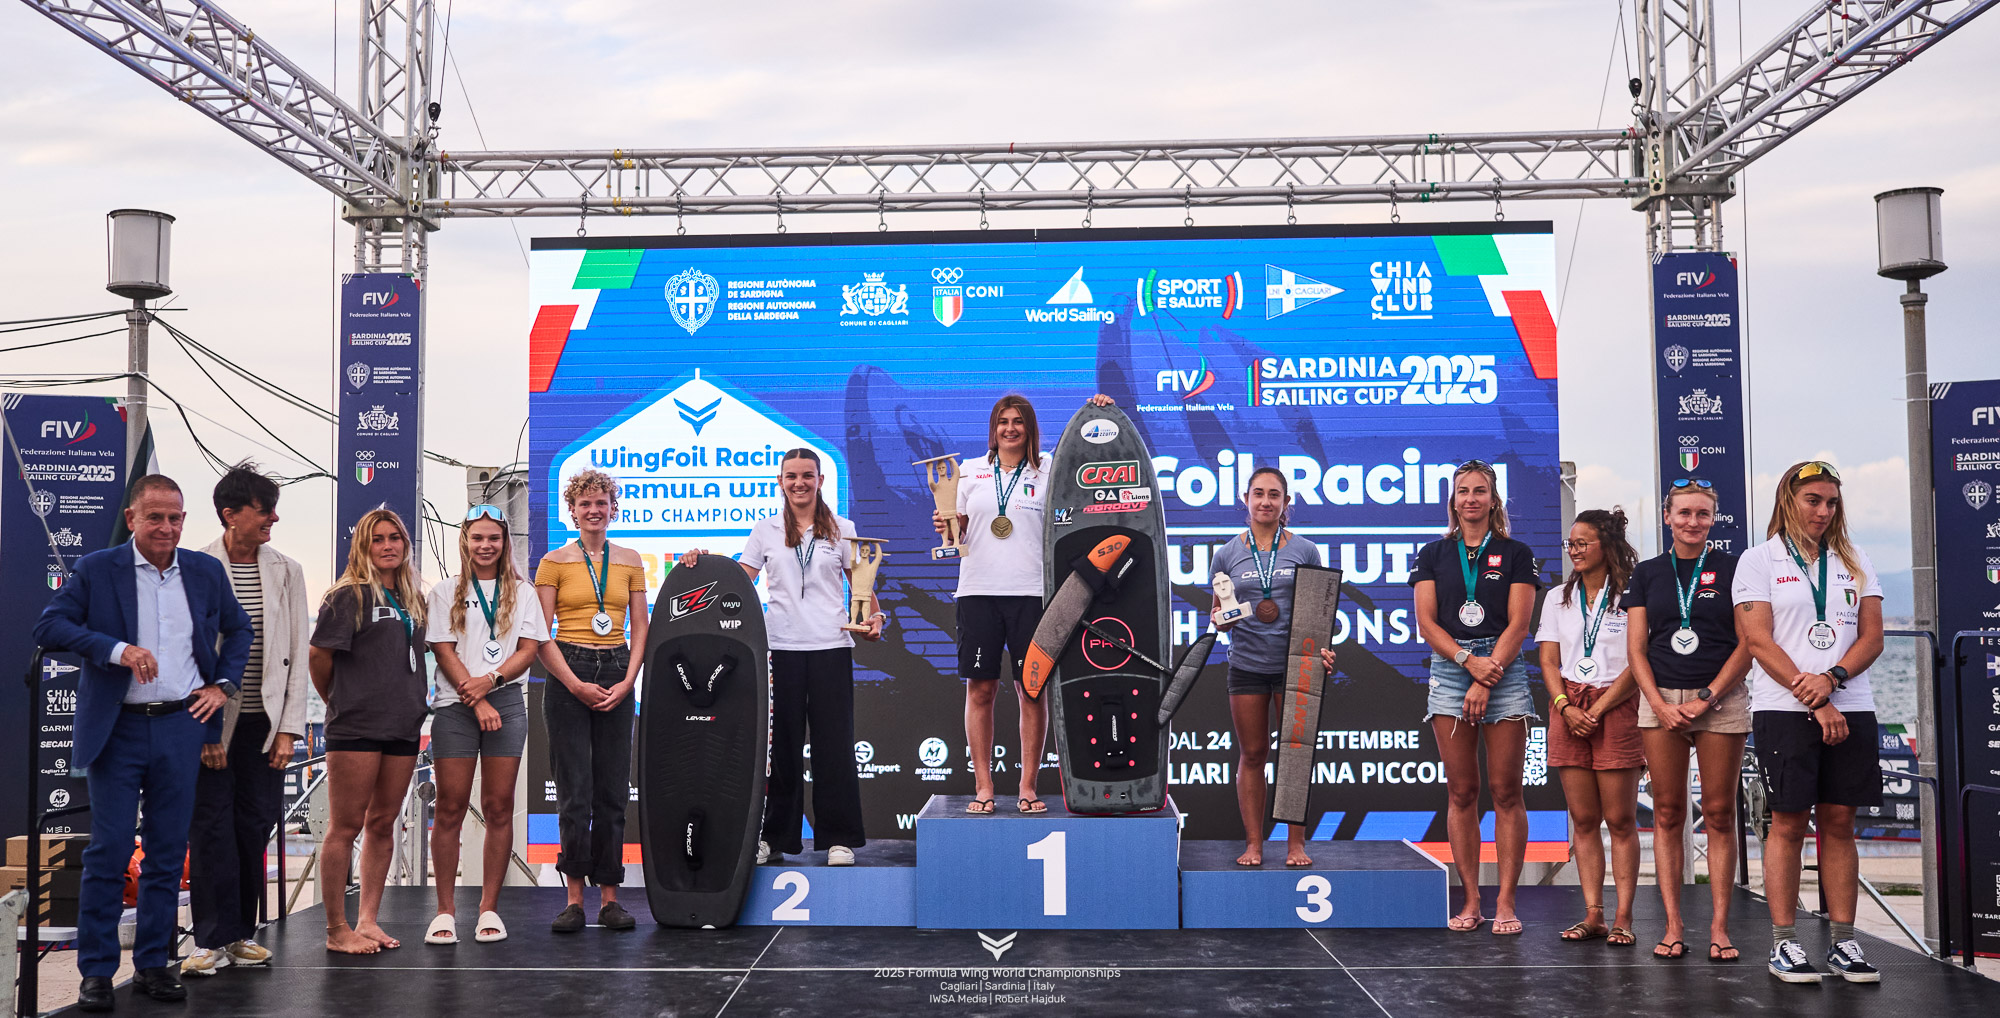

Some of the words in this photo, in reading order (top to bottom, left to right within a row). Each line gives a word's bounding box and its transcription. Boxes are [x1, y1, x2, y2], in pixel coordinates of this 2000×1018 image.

[1370, 260, 1432, 278] CHIA
[728, 280, 765, 289] REGIONE
[1676, 272, 1705, 286] FIV
[728, 290, 740, 298] DE
[740, 289, 784, 298] SARDIGNA
[966, 286, 1004, 298] CONI
[1157, 278, 1222, 296] SPORT
[1294, 286, 1332, 296] CAGLIARI
[1370, 278, 1432, 296] WIND
[362, 292, 390, 305] FIV
[728, 302, 765, 310] REGIONE
[766, 300, 816, 310] AUTONOMA
[1157, 296, 1166, 308] E
[1168, 296, 1222, 308] SALUTE
[1370, 294, 1433, 312] CLUB
[728, 312, 752, 320] DELLA
[753, 312, 800, 320] SARDEGNA
[1024, 308, 1068, 322] World
[1068, 307, 1115, 324] Sailing
[1704, 314, 1731, 327] 2025
[386, 332, 412, 346] 2025
[1156, 370, 1200, 392] FIV
[1261, 356, 1398, 378] SARDINIA
[1400, 354, 1498, 406] 2025
[1261, 388, 1348, 406] SAILING
[1354, 388, 1398, 406] CUP
[1136, 403, 1184, 412] Federazione
[1186, 404, 1216, 412] Italiana
[1216, 404, 1235, 412] Vela
[41, 420, 82, 438] FIV
[20, 448, 66, 456] Federazione
[1701, 446, 1726, 454] CONI
[1956, 452, 2000, 462] SARDIN
[590, 446, 708, 473] WingFoil
[716, 444, 786, 467] Racin
[24, 464, 78, 472] SARDINIA
[78, 464, 115, 482] 2025
[1956, 463, 1992, 471] SAILING
[1082, 466, 1136, 484] CRAI
[620, 483, 720, 499] RMULA
[729, 482, 782, 498] WIN
[662, 508, 785, 523] CHAMPIONSH
[1714, 513, 1734, 524] iling
[1706, 540, 1732, 550] ORT
[1241, 568, 1294, 578] OZNE
[1776, 576, 1800, 584] SLAM
[720, 620, 742, 629] WIP
[46, 696, 76, 704] WIND
[1290, 638, 1314, 749] CHUBANGA
[1206, 730, 1232, 750] 24
[1316, 730, 1419, 750] ETTEMBRE
[863, 763, 901, 775] Airport
[1168, 762, 1230, 785] LIARI
[1362, 762, 1448, 785] PICCOL
[1026, 831, 1067, 916] 1
[772, 870, 810, 921] 2
[1295, 875, 1334, 923] 3
